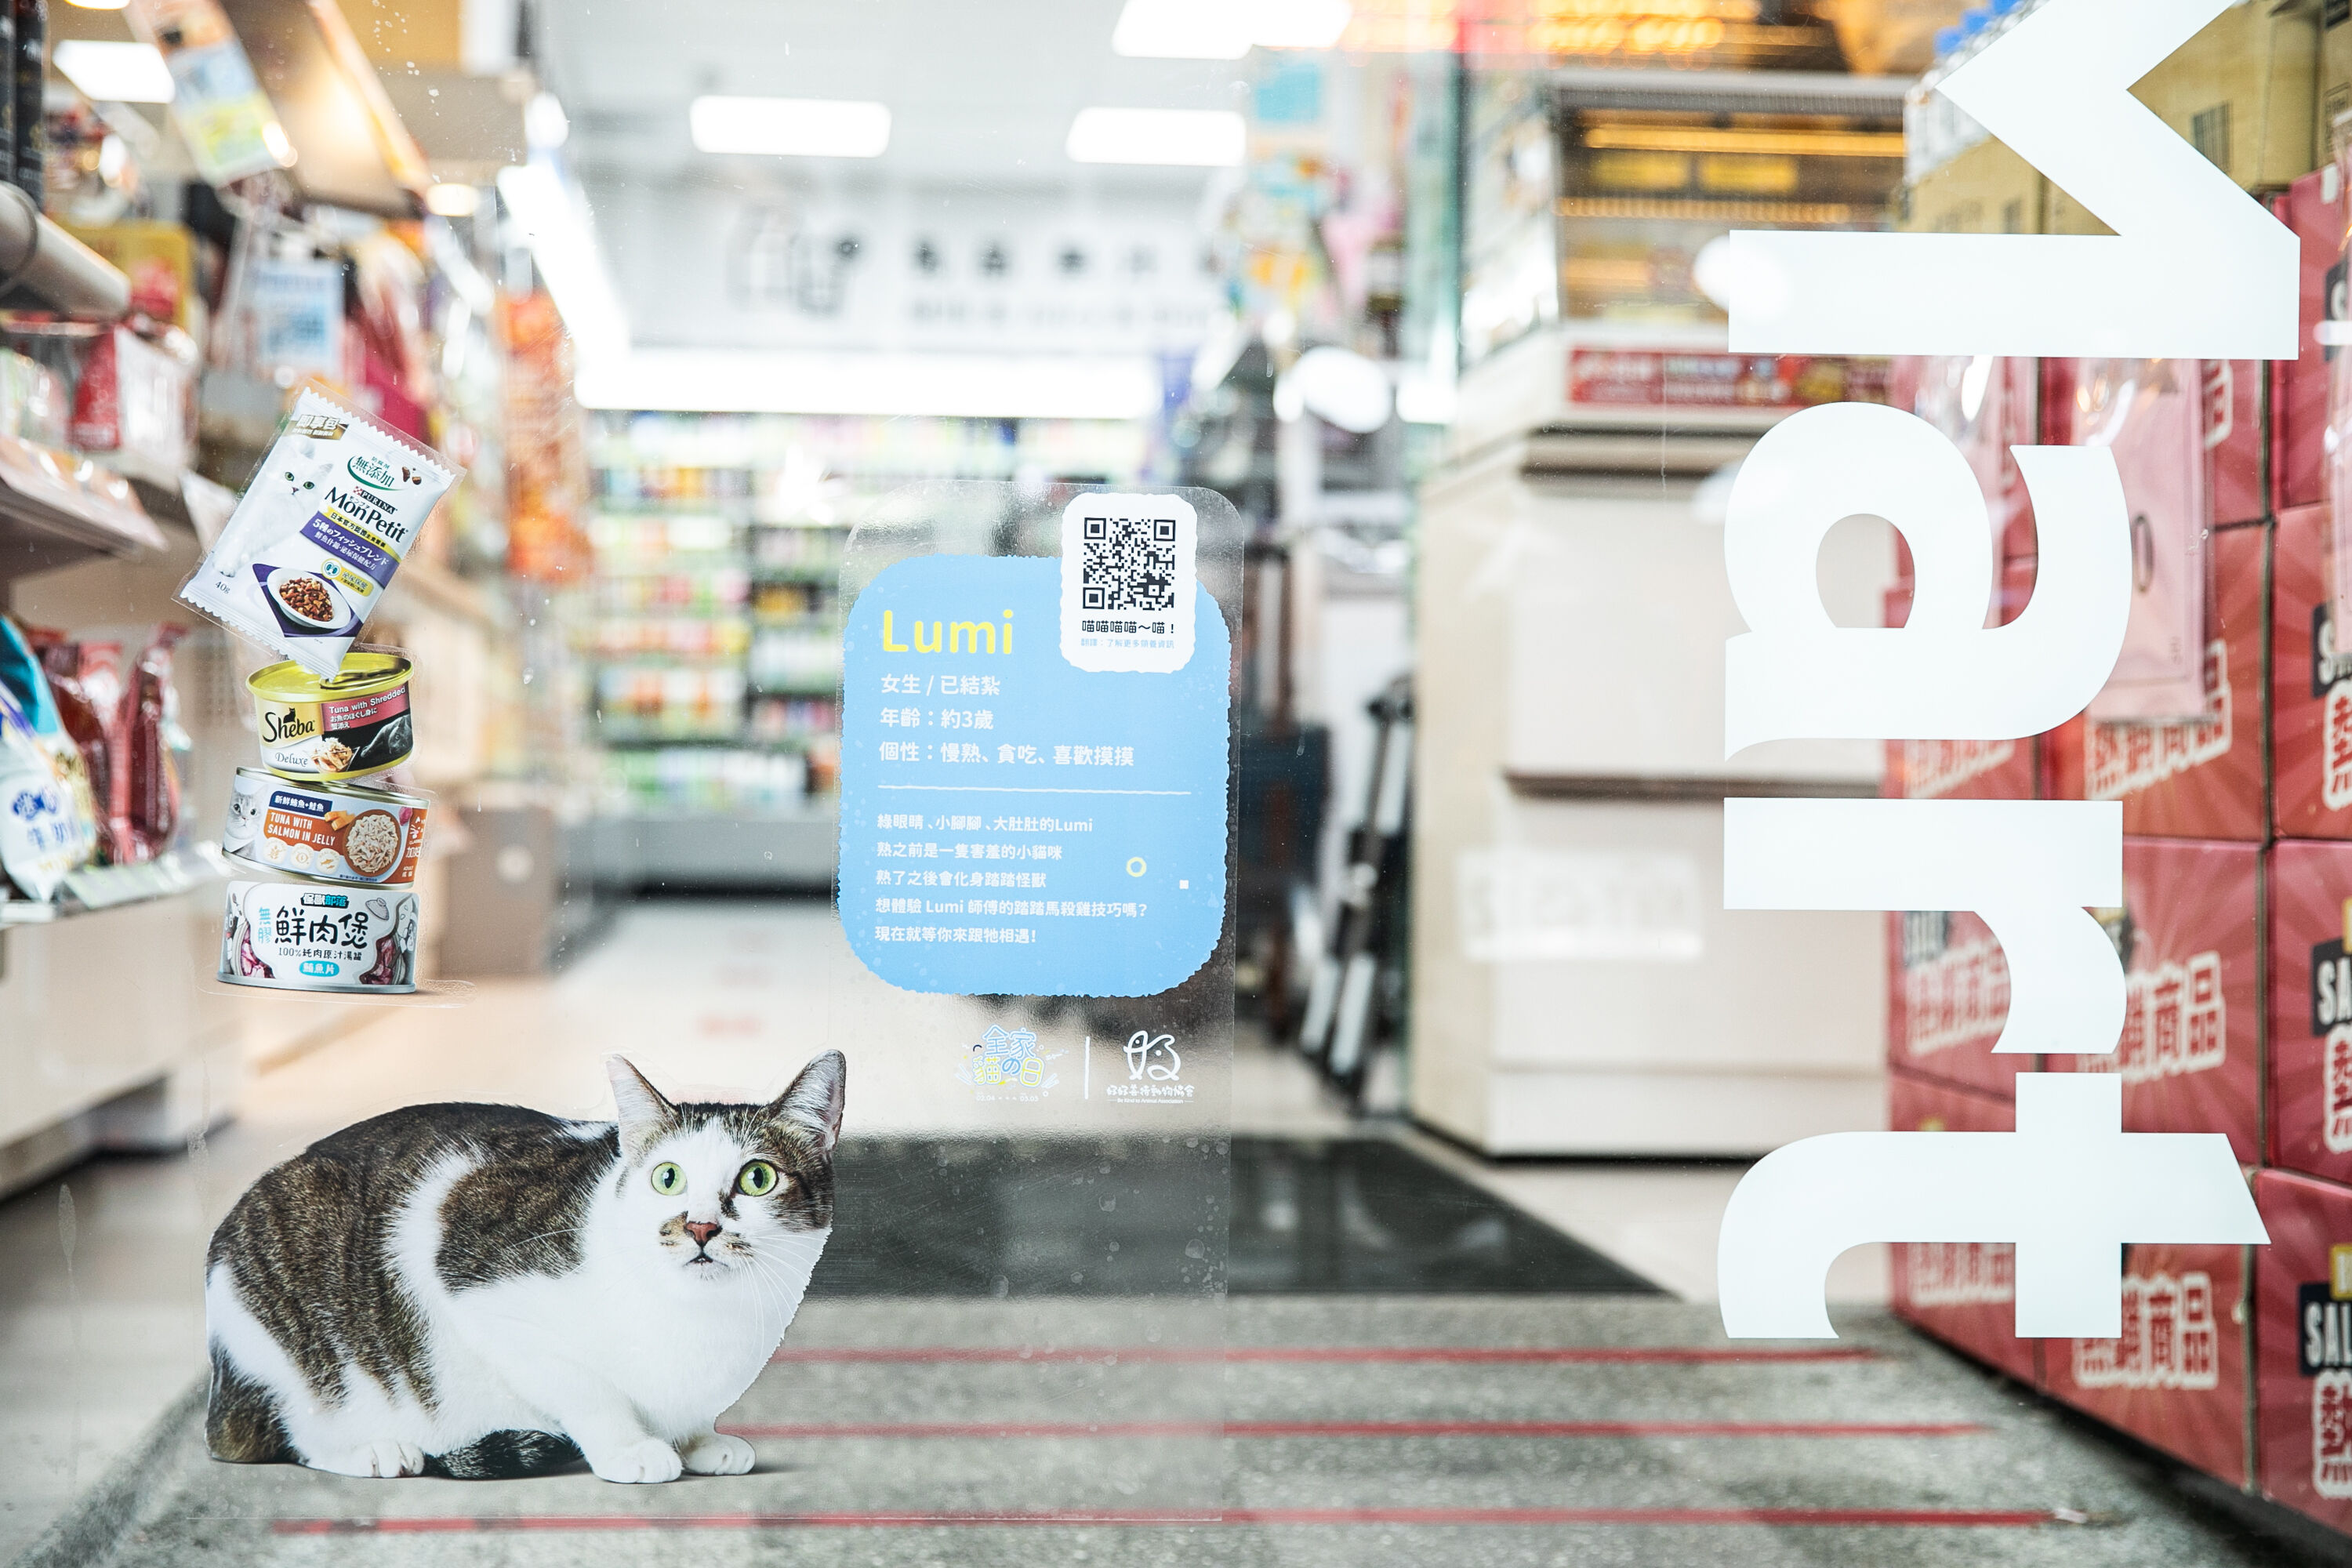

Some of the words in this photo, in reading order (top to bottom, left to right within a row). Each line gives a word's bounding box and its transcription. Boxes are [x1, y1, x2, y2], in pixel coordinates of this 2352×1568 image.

[352, 456, 394, 487] 無添加
[361, 491, 394, 514] PURINA
[313, 518, 389, 566] 5種のフィッシュブレンド
[215, 581, 230, 594] 40g
[883, 609, 1014, 655] Lumi
[880, 673, 921, 695] 女生
[926, 674, 934, 696] /
[940, 675, 1001, 696] 已結紮
[328, 706, 349, 714] Tuna
[351, 702, 368, 711] with
[370, 687, 406, 706] Shredded
[263, 711, 315, 743] Sheba
[275, 752, 308, 768] Deluxe
[270, 812, 290, 826] TUNA
[293, 816, 313, 829] WITH
[267, 824, 300, 840] SALMON
[302, 832, 311, 842] IN
[312, 833, 336, 846] JELLY
[877, 842, 1063, 861] 熟之前是一隻害羞的小貓咪
[876, 869, 1047, 888] 熟了之後會化身踏踏怪獸
[875, 897, 922, 914] 想體驗
[926, 899, 964, 913] Lumi
[258, 906, 272, 944] 無膠
[274, 906, 369, 949] 鮮肉煲
[982, 1024, 1036, 1058] 全家
